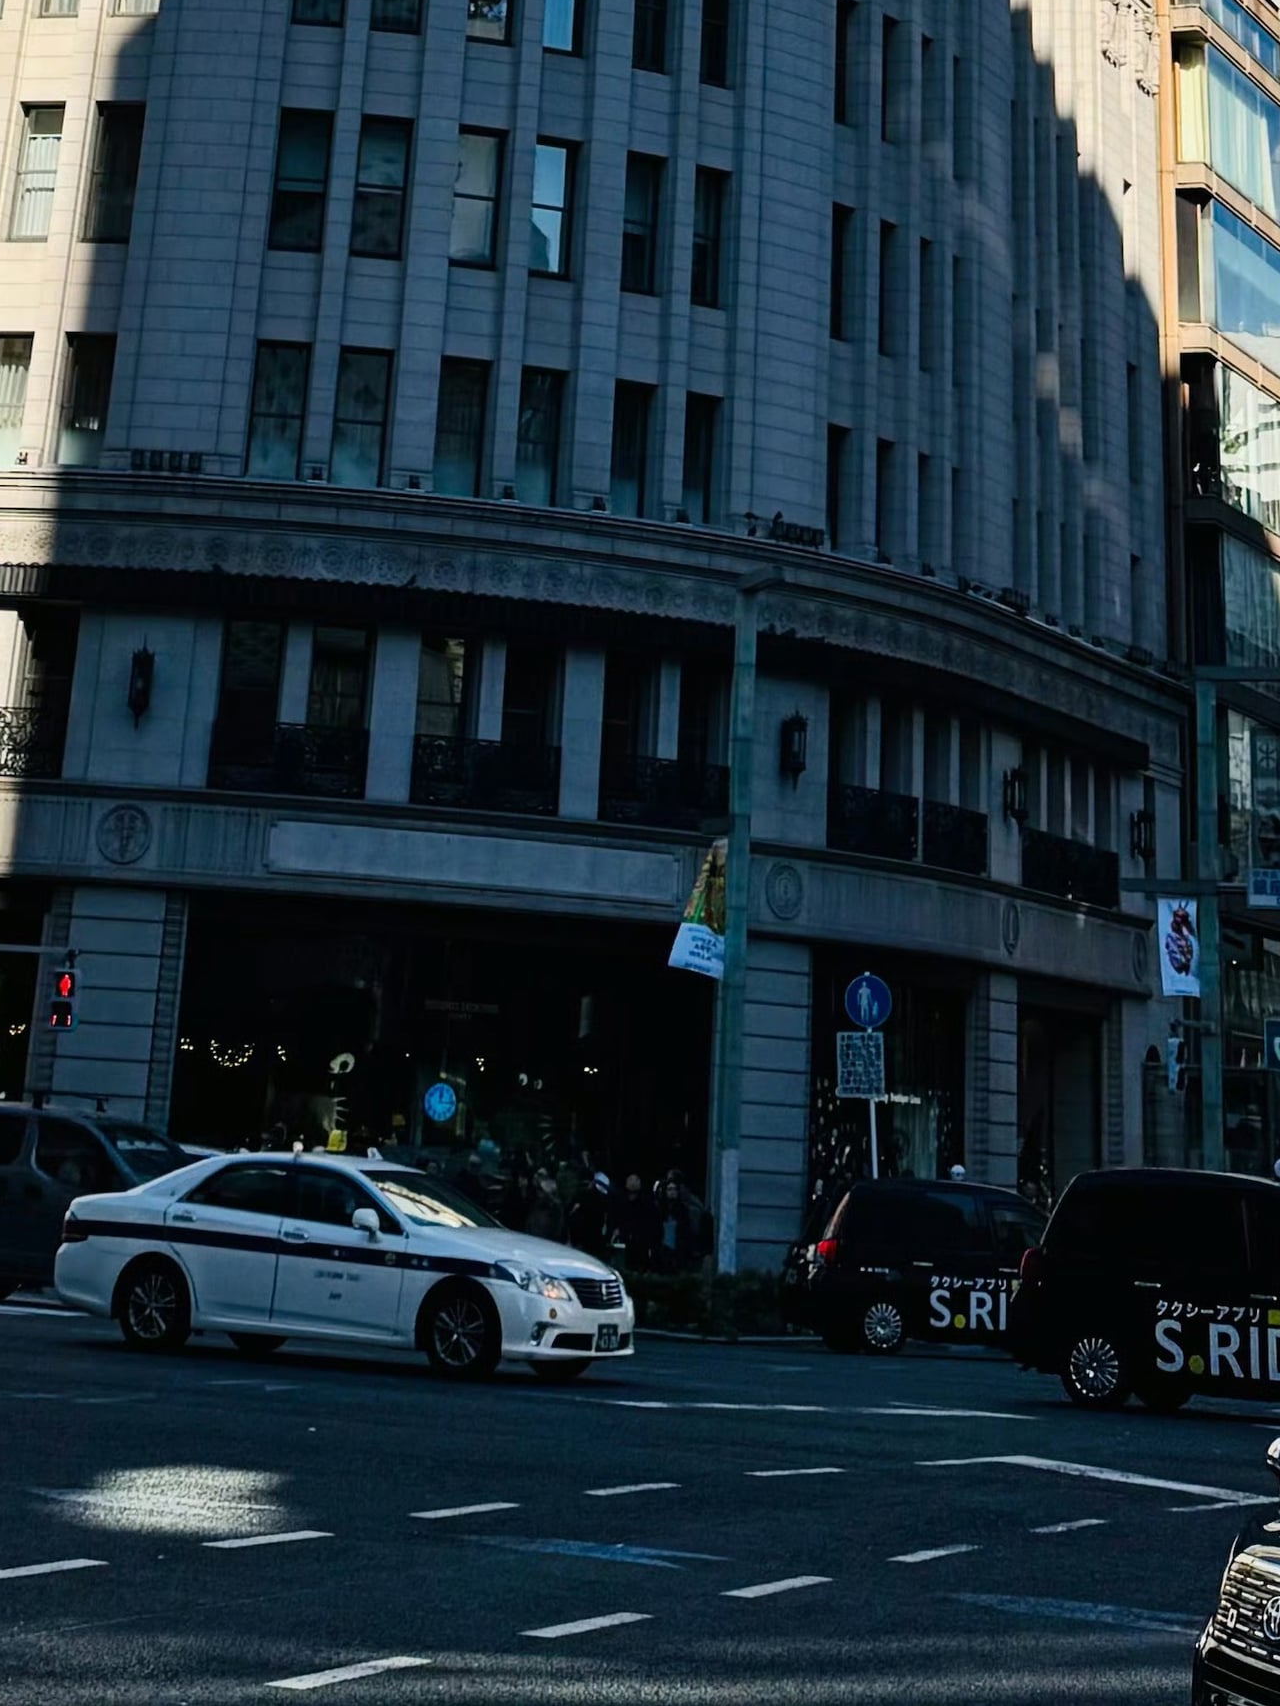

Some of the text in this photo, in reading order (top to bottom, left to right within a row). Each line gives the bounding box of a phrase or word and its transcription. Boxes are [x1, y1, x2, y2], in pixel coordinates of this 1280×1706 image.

[929, 1275, 1008, 1291] タクシーアプリ
[929, 1288, 1007, 1331] S.RI
[1156, 1299, 1261, 1323] タクシーアプリ
